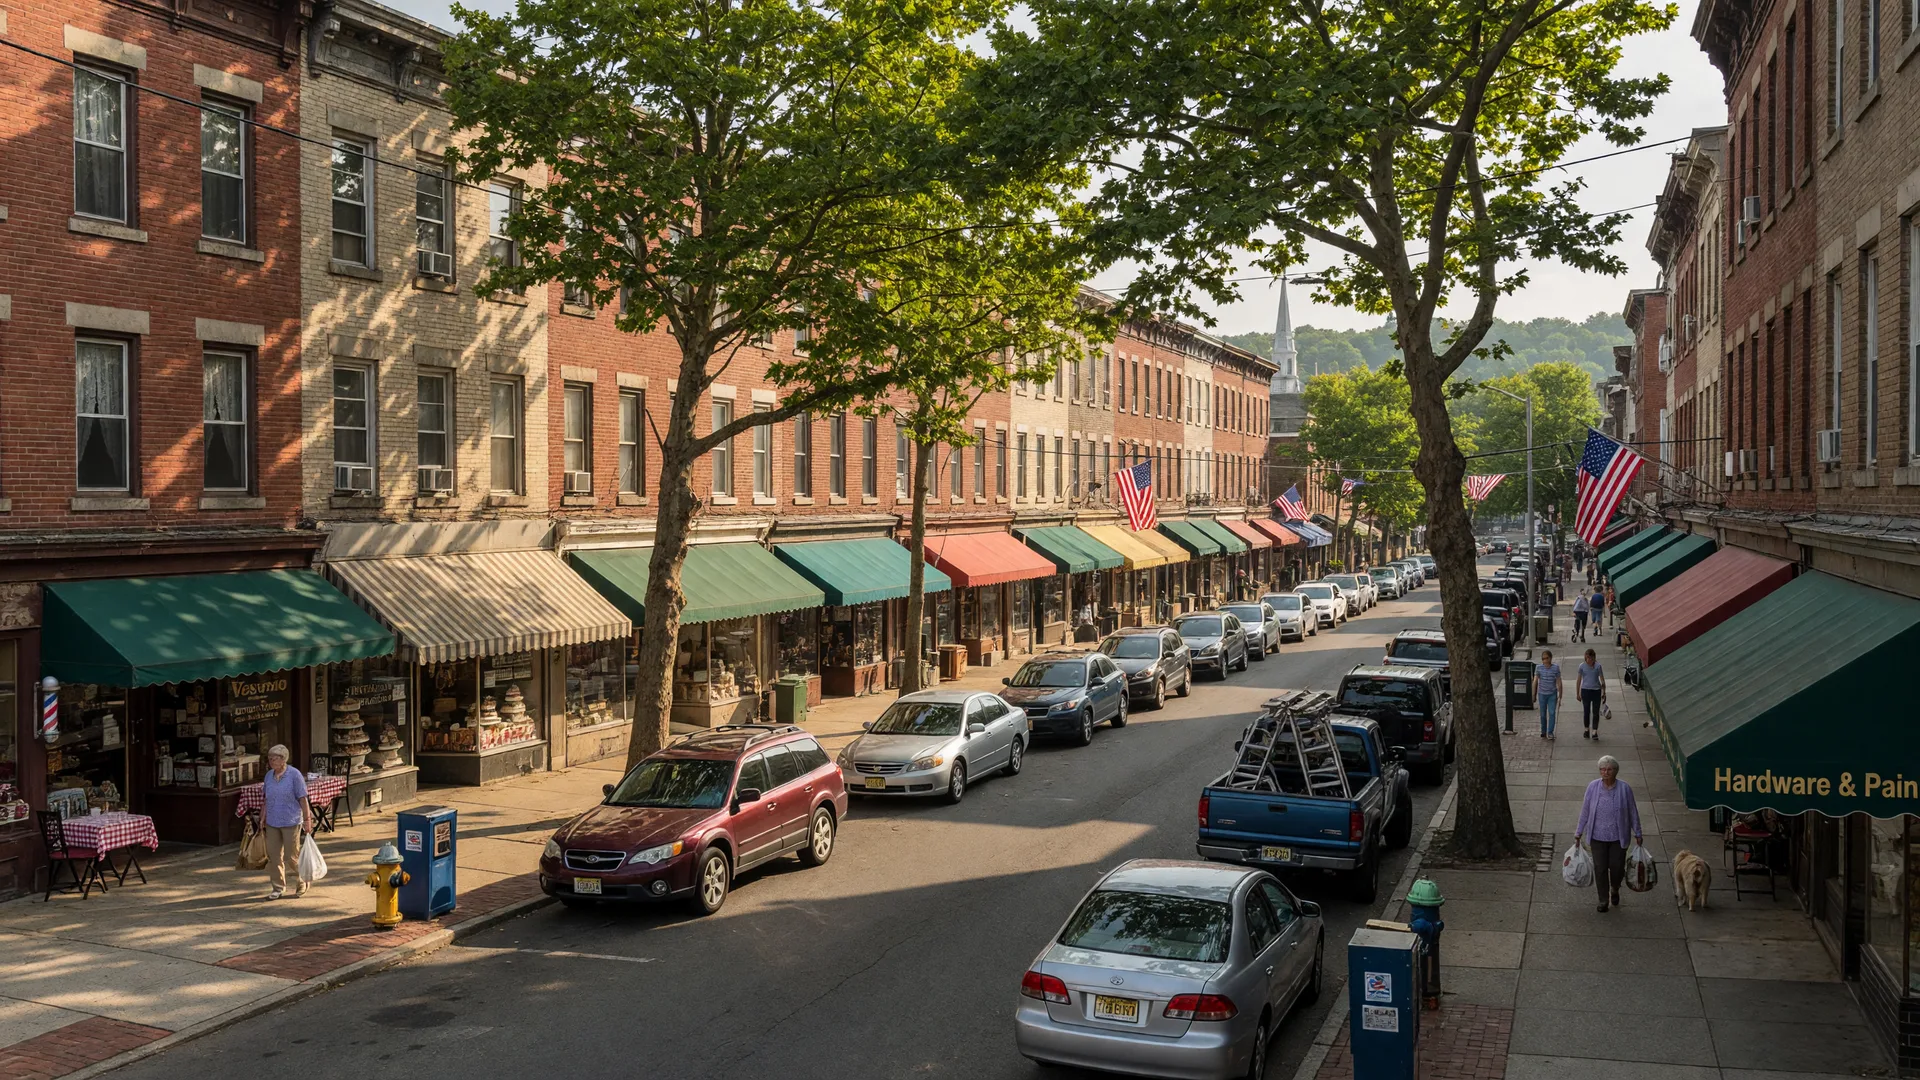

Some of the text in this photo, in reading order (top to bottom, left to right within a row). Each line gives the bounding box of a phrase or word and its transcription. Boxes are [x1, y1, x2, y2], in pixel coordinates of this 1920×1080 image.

[1714, 767, 1919, 799] Hardware & Pain
